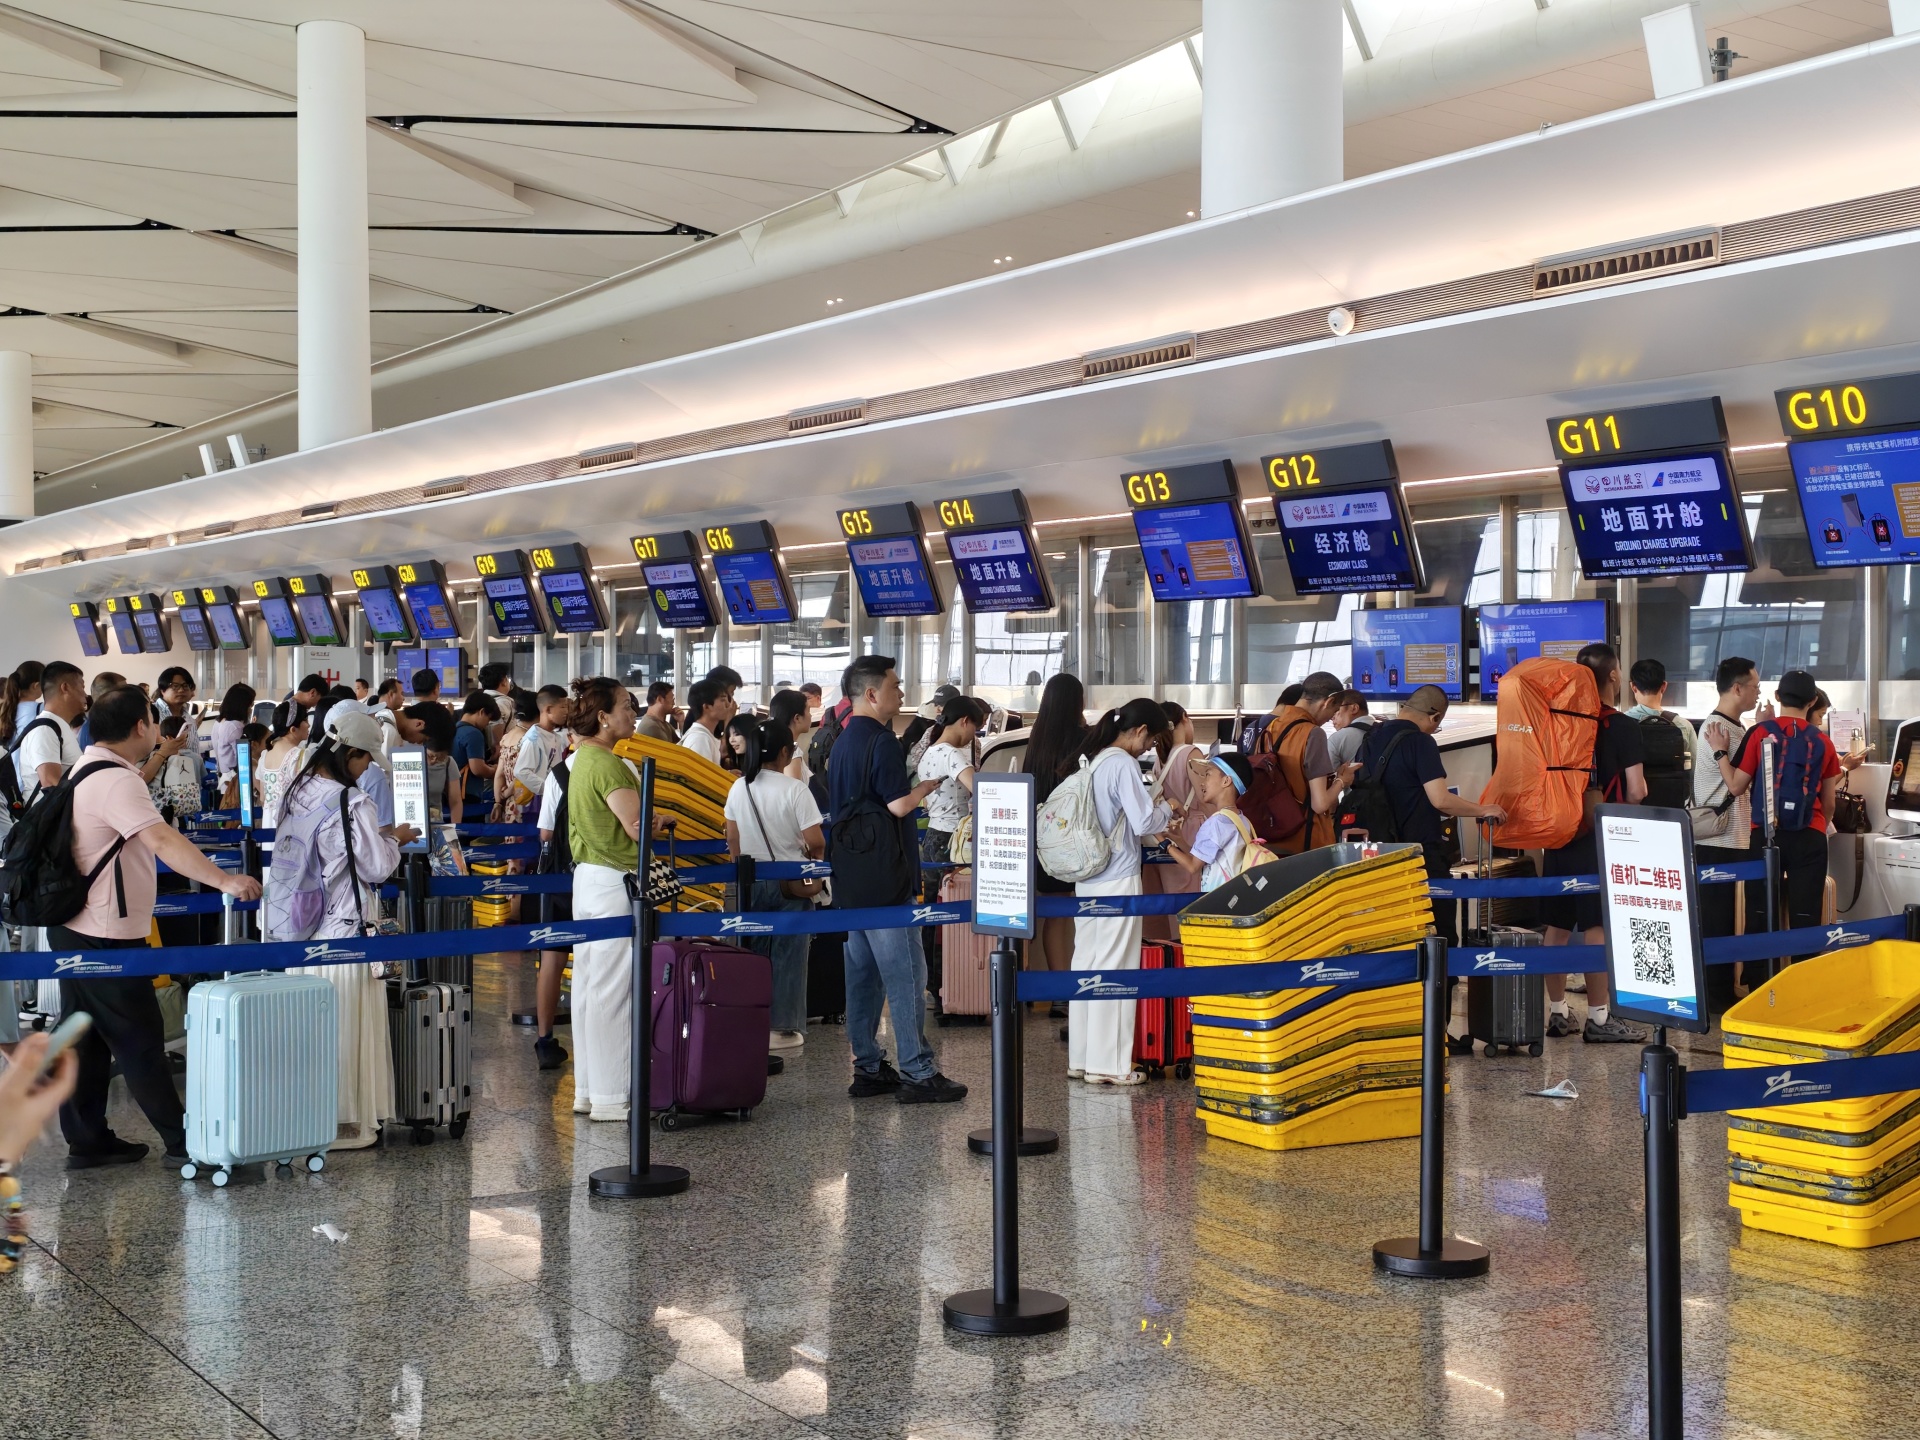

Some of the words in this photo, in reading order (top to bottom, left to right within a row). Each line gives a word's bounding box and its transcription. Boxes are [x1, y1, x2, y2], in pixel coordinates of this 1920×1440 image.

[1788, 386, 1867, 430] G10
[1558, 415, 1621, 454] G11
[1846, 436, 1920, 452] 携带充电宝乘机附加要
[1269, 454, 1321, 488] G12
[1602, 472, 1642, 486] 四川航空
[1668, 470, 1702, 479] 中国南方航空
[1128, 472, 1171, 504] G13
[940, 499, 974, 527] G14
[1304, 503, 1335, 515] 四川航空
[1601, 501, 1704, 532] 地面升舱
[842, 509, 872, 535] G15
[634, 537, 658, 559] G17
[706, 527, 733, 551] G16
[1314, 529, 1371, 554] 经济舱
[1614, 540, 1642, 552] GROUND
[1642, 538, 1670, 550] CHARGE
[1668, 536, 1702, 548] UPGRADE
[476, 555, 497, 575] G19
[532, 548, 555, 569] G18
[1327, 561, 1351, 571] ECONOMY
[1351, 559, 1369, 569] CLASS
[352, 570, 370, 588] G21
[398, 564, 416, 583] G20
[868, 568, 914, 587] 地面升舱
[969, 560, 1021, 581] 地面升舱
[991, 807, 1018, 820] 温馨提示
[1611, 863, 1682, 891] 值机二维码
[1613, 893, 1684, 912] 扫码领取电子登机牌
